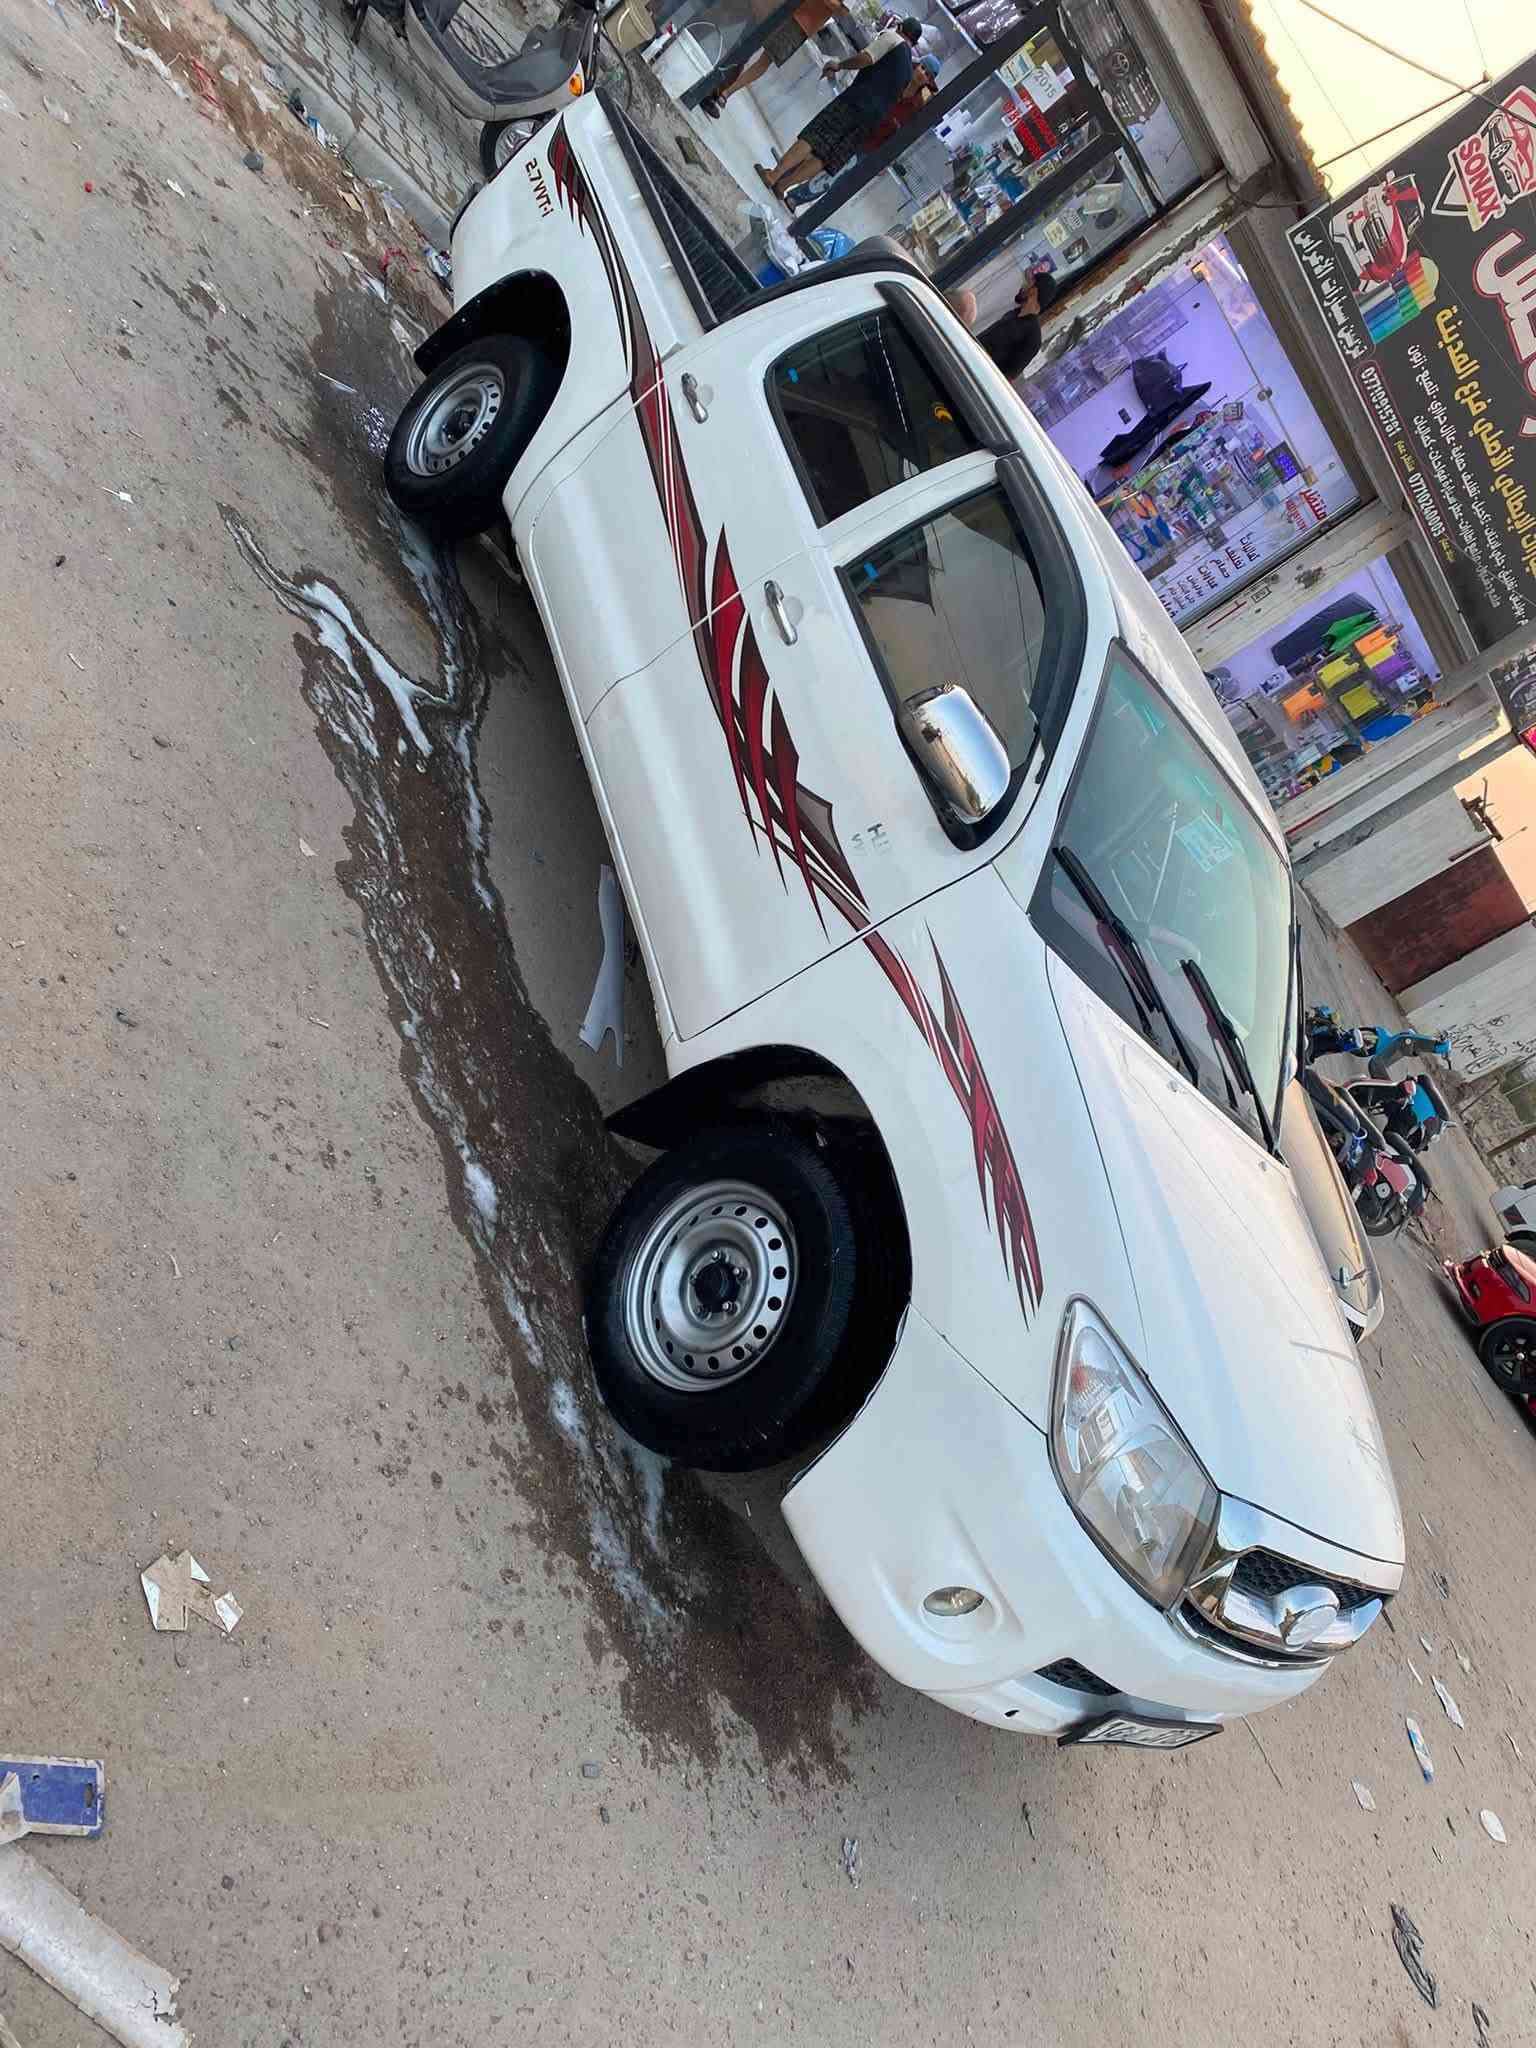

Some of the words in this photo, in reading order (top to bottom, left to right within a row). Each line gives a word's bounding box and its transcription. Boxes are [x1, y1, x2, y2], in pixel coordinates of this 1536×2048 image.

[1034, 70, 1056, 98] 2015
[1459, 138, 1502, 222] SONAX
[1436, 305, 1480, 380] المدينة
[1416, 370, 1439, 395] تلميع
[1428, 401, 1447, 425] حراري
[1455, 381, 1492, 416] فرع
[1414, 416, 1436, 448] كماليات
[1440, 425, 1456, 444] عازل
[1468, 418, 1514, 472] الأصلي
[1450, 447, 1466, 471] حماية
